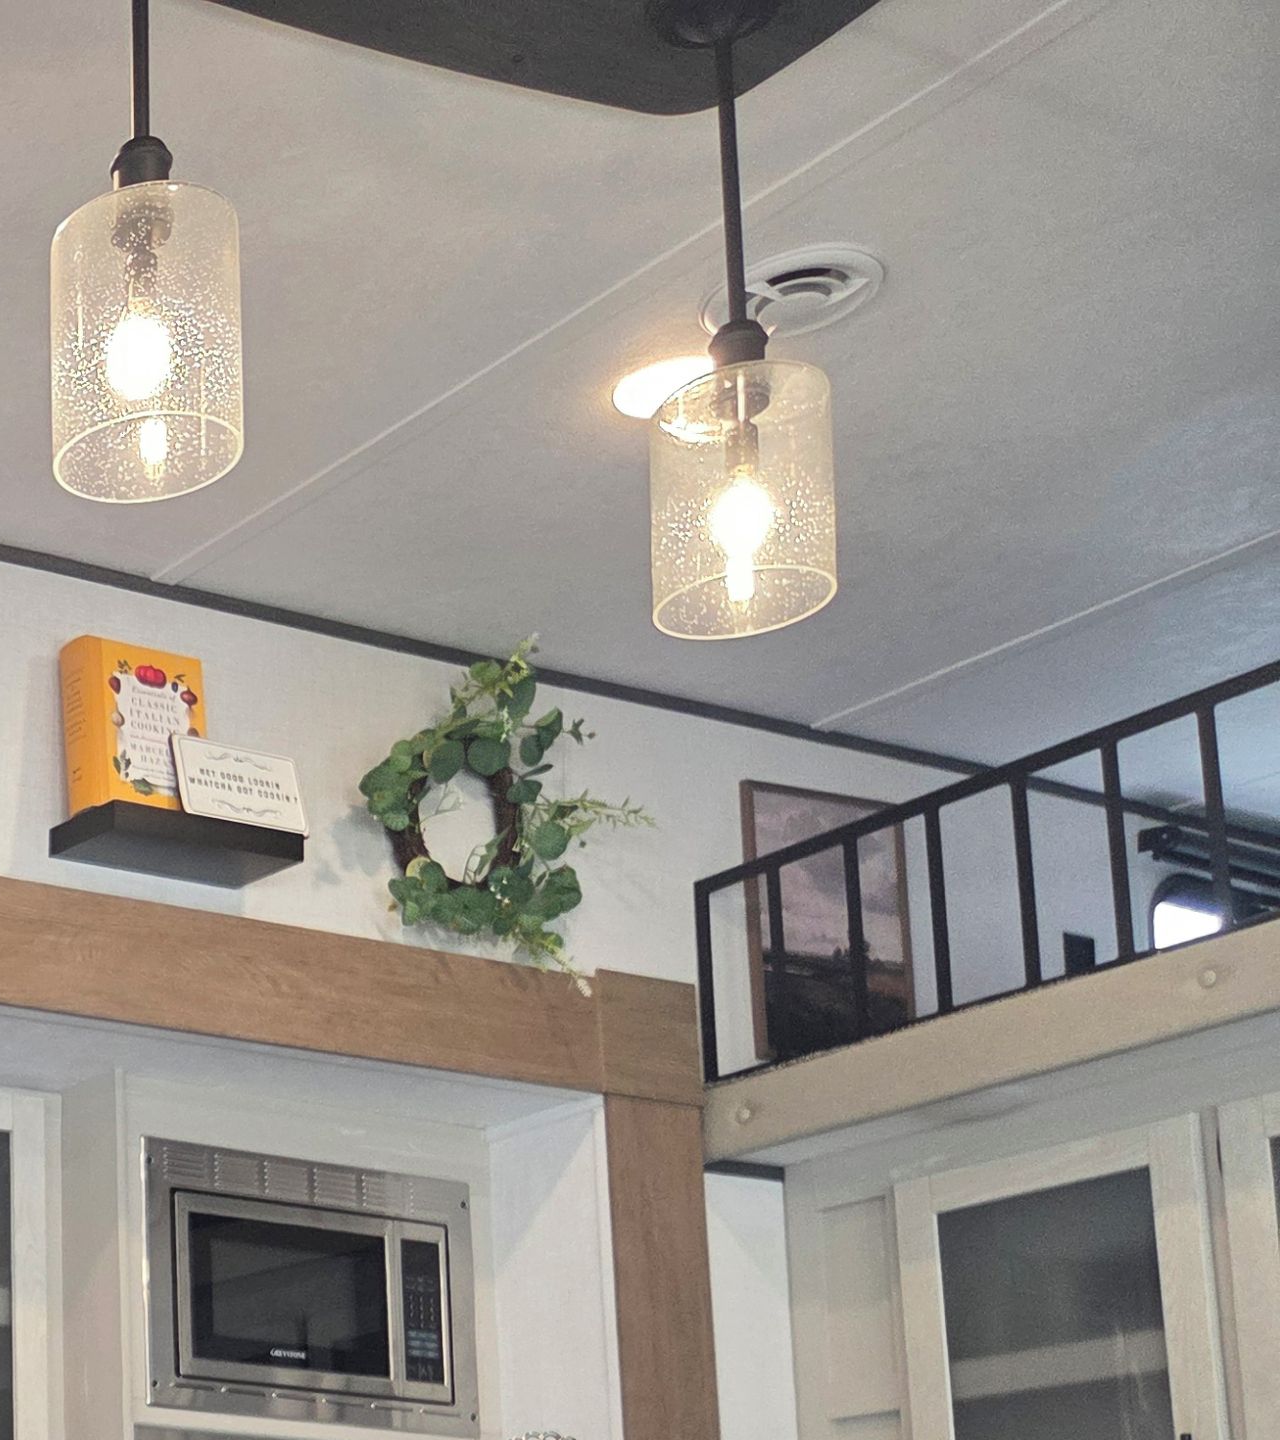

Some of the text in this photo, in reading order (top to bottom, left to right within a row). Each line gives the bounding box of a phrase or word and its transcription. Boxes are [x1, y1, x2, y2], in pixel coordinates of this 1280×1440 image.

[131, 697, 177, 713] CLASSIC
[130, 708, 180, 725] ITALIAN
[220, 772, 244, 783] GOOD
[188, 776, 232, 792] WHATCHA
[237, 786, 253, 796] GOT
